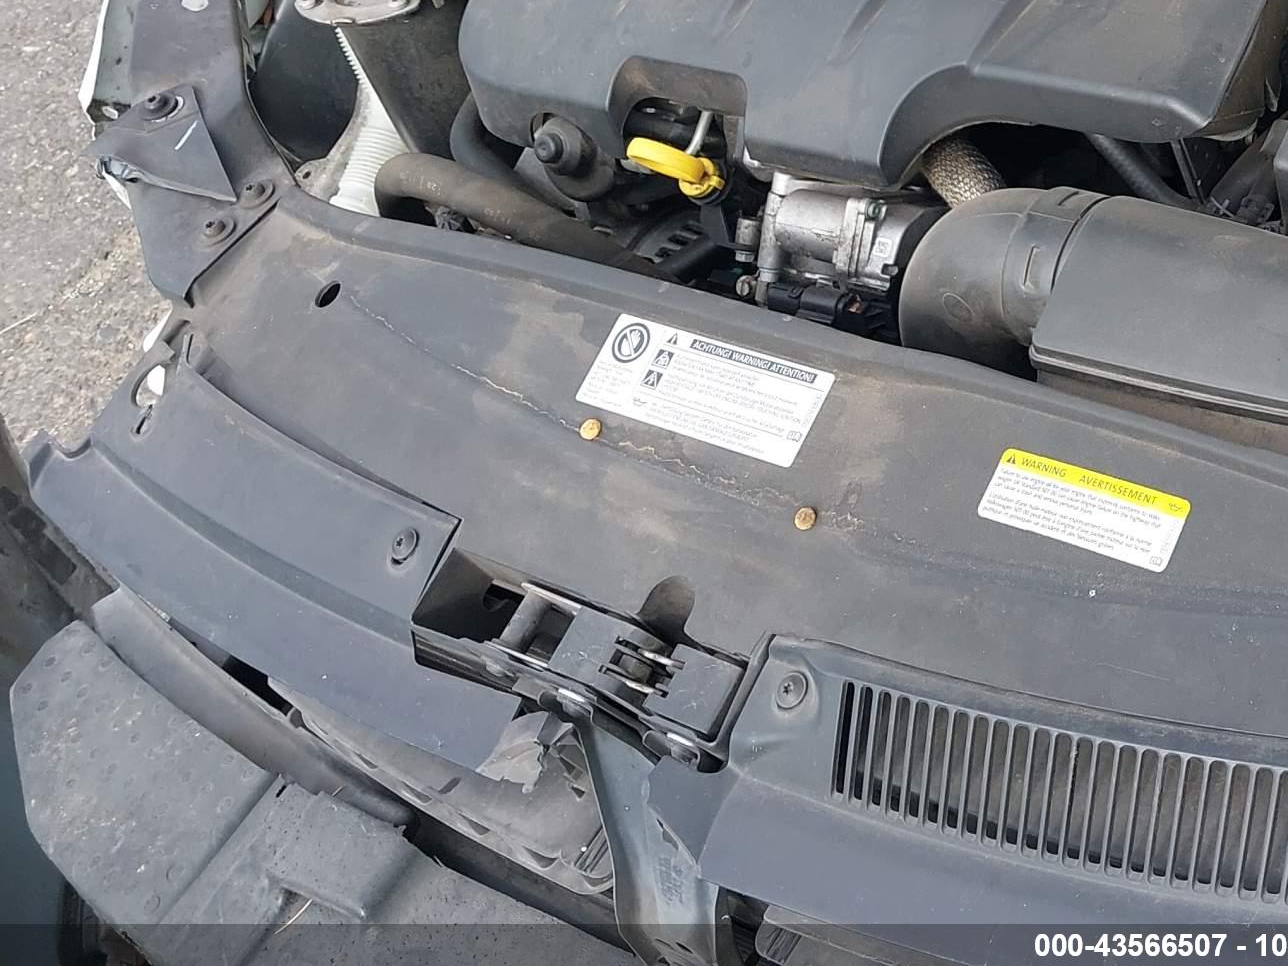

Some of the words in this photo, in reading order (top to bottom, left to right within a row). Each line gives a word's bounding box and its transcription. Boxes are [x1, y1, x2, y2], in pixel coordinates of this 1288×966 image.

[693, 340, 732, 361] ACHTUNG!
[731, 352, 771, 372] WARNING!
[769, 362, 814, 382] ATTENTION!
[1021, 456, 1067, 478] WARNING
[1079, 474, 1159, 505] AVERTISSEMENT
